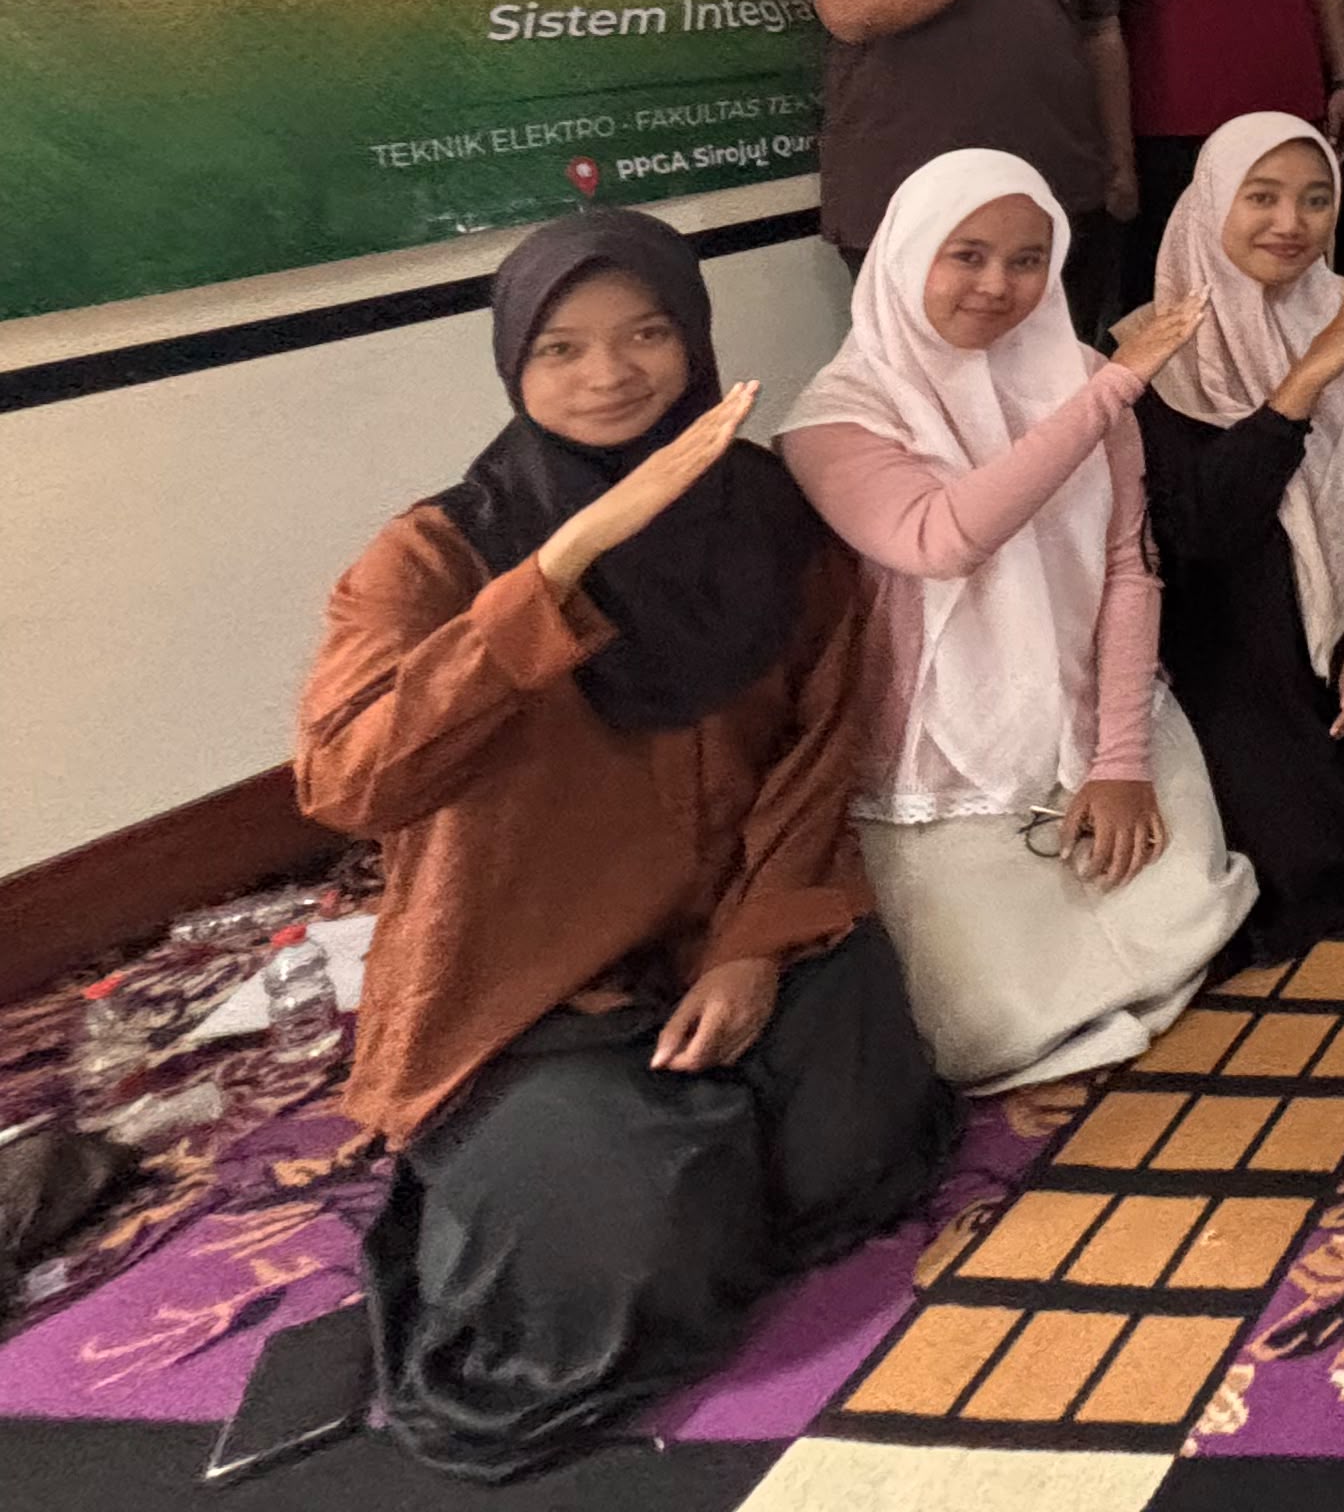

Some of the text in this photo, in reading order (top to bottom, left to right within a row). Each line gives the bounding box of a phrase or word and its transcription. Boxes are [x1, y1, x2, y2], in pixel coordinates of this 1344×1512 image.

[487, 1, 667, 41] Sistem
[369, 129, 486, 169] TEKNIK
[491, 115, 616, 155] ELEKTRO
[635, 98, 759, 132] FAKULTAS
[616, 149, 690, 182] PPGA
[772, 134, 822, 158] Qur
